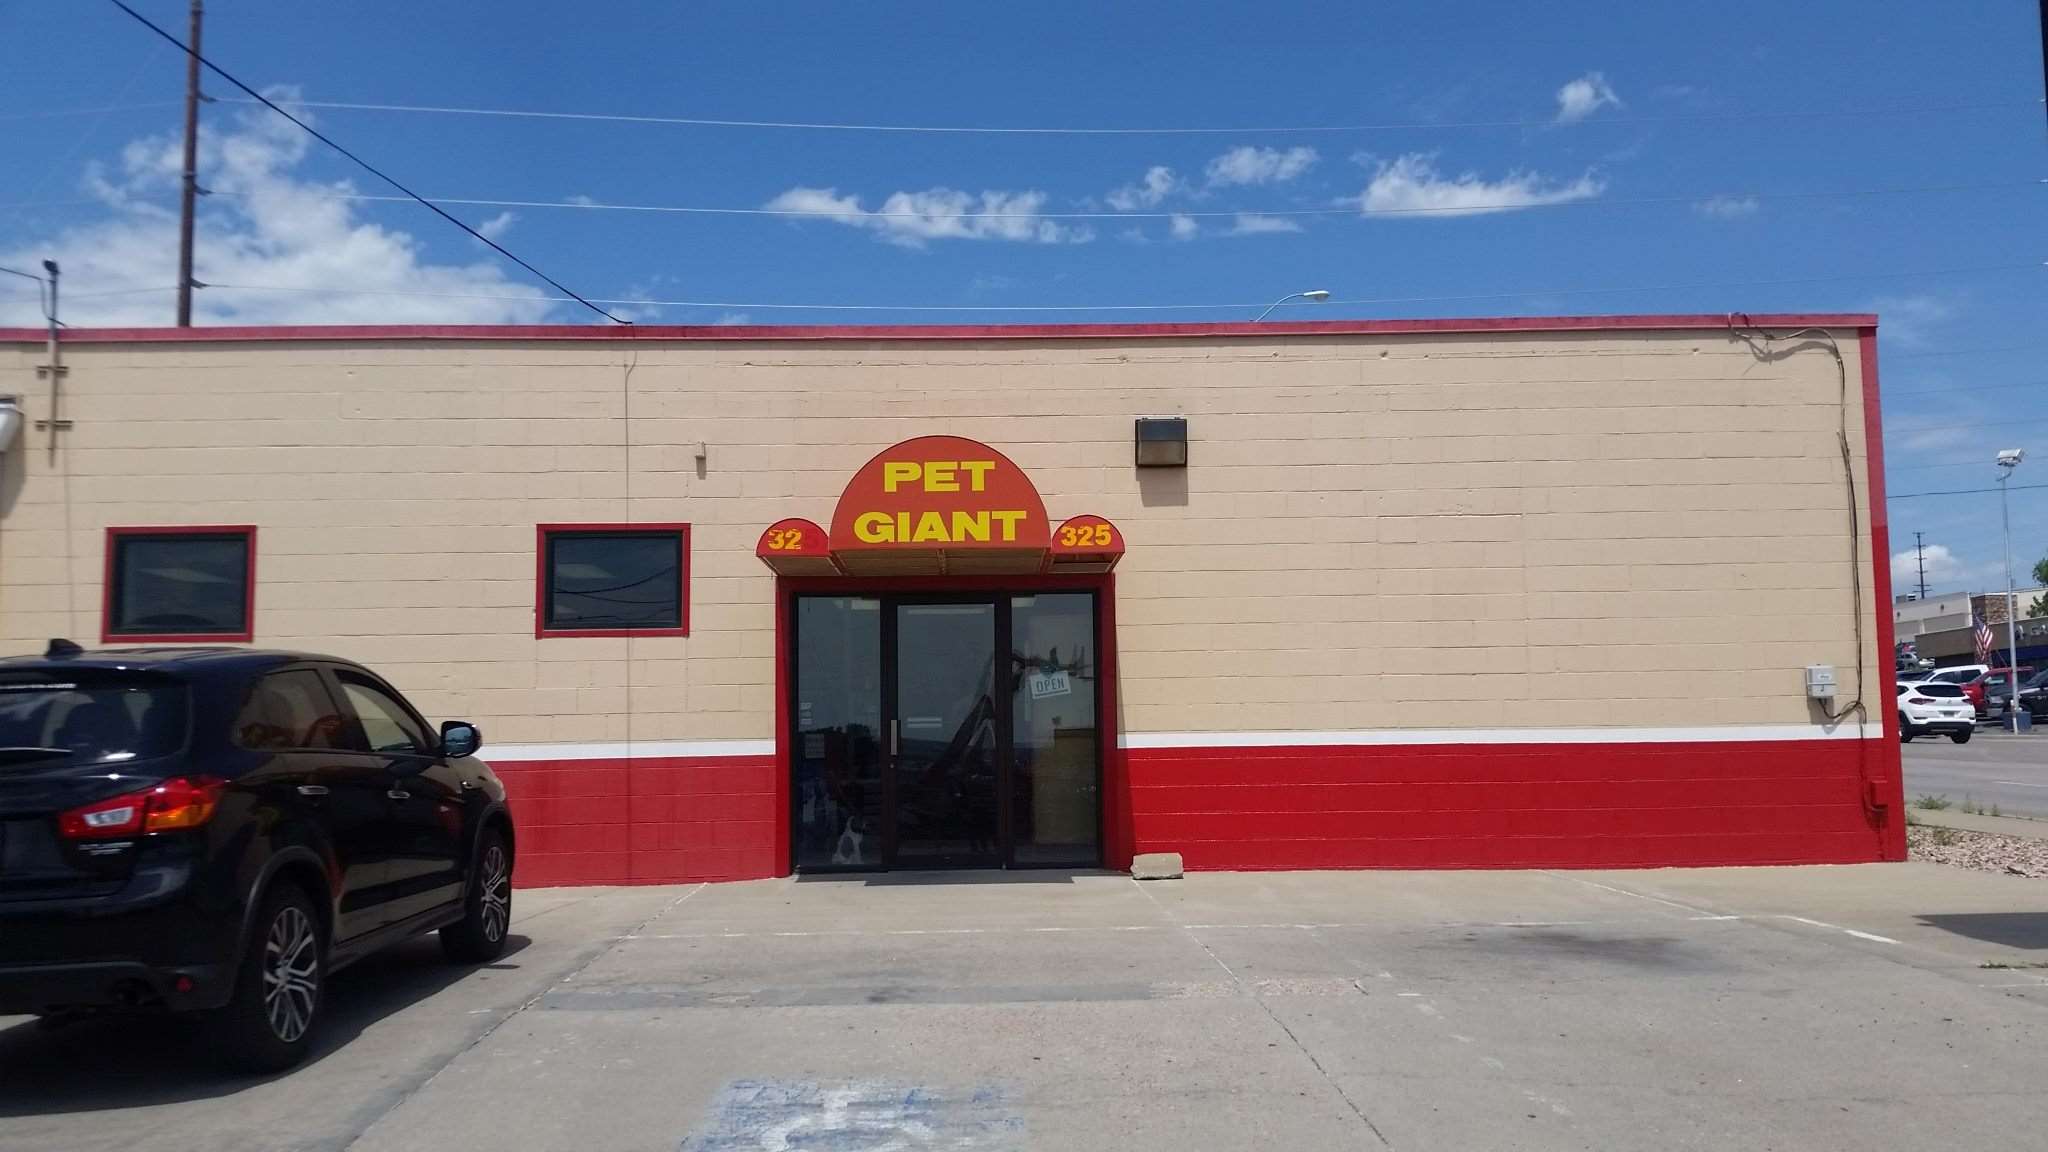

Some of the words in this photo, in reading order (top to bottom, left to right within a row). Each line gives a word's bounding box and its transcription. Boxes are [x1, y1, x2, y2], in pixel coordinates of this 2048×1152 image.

[883, 460, 996, 493] PET
[853, 510, 1027, 544] GIANT
[1060, 523, 1112, 547] 325
[1035, 676, 1065, 693] OPEN
